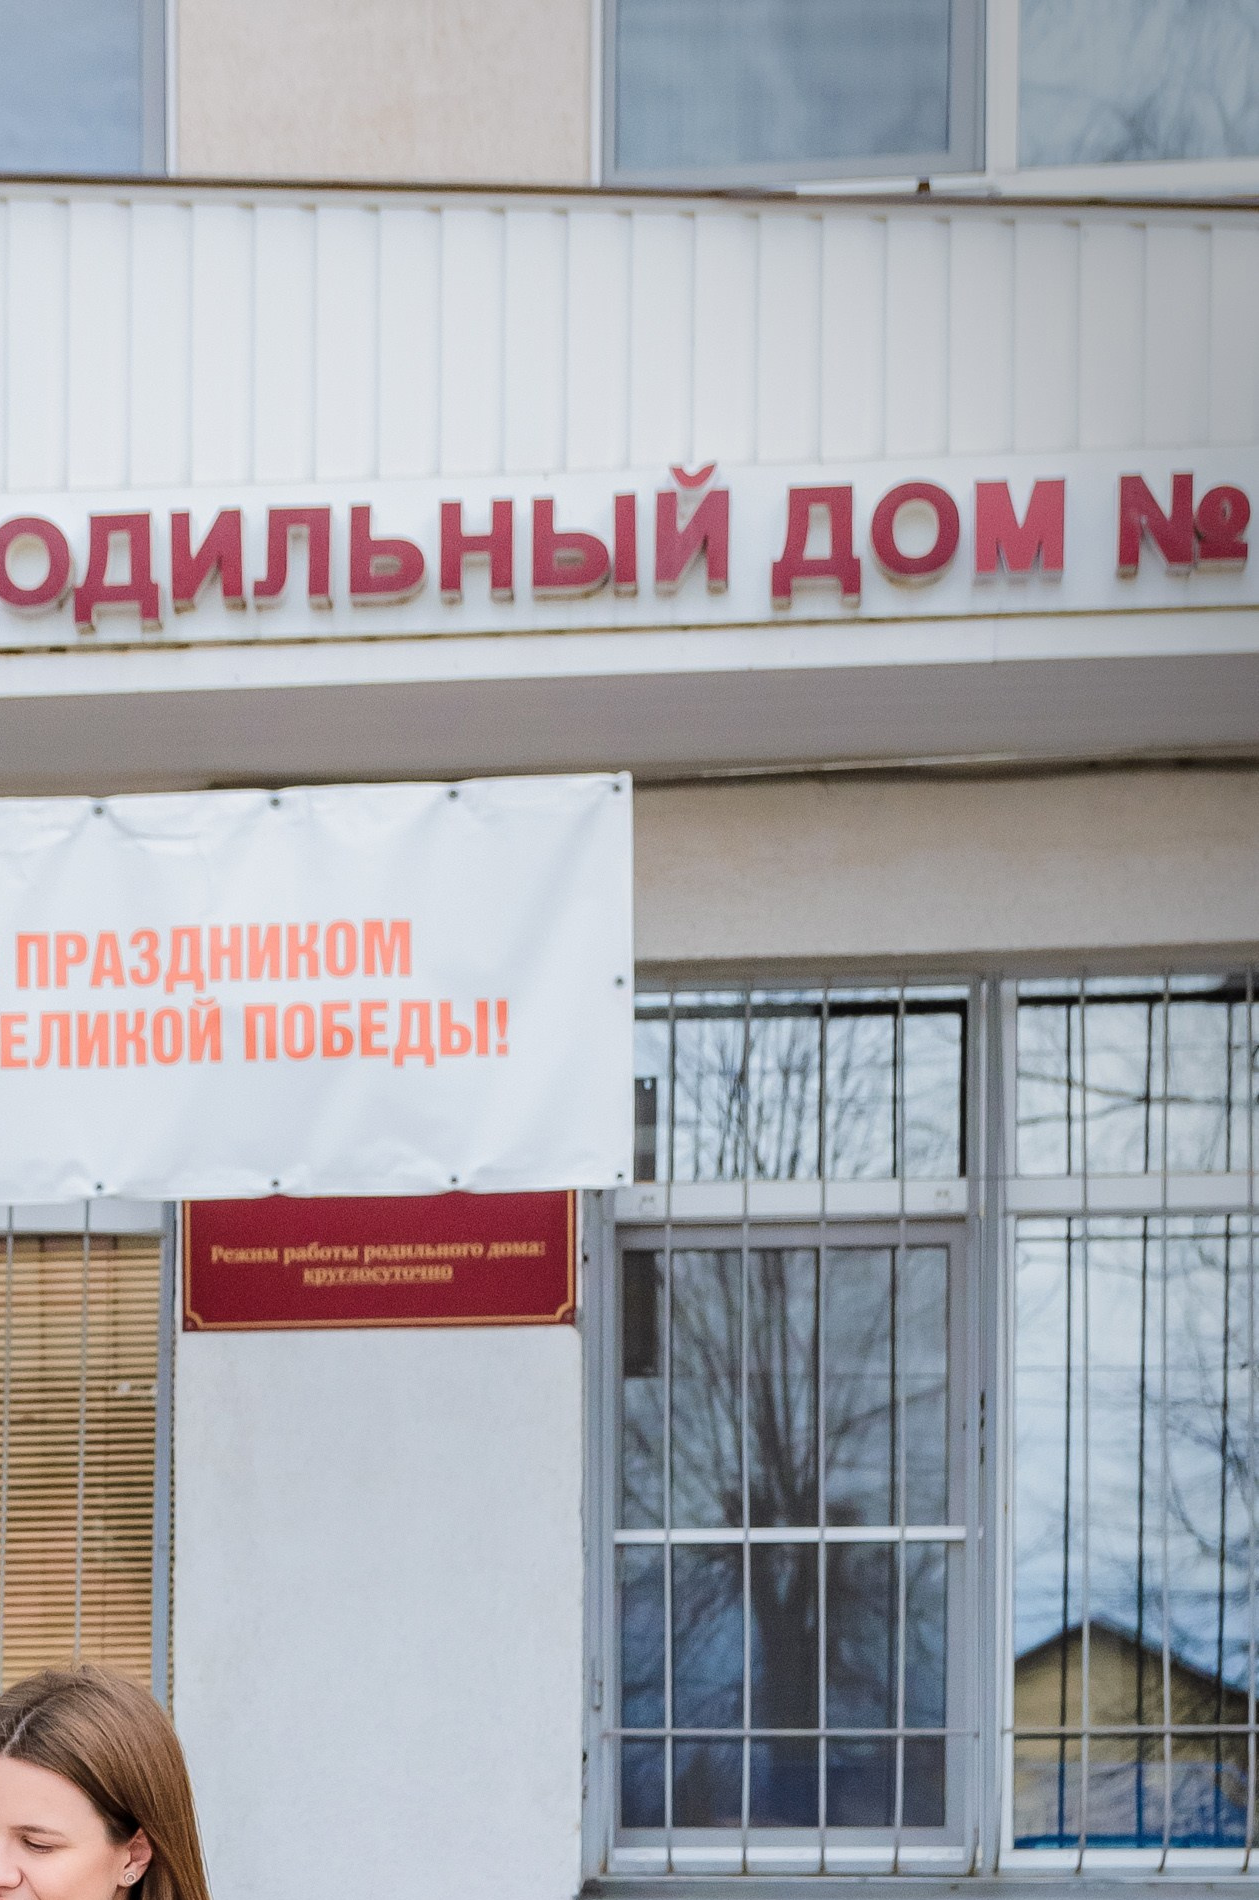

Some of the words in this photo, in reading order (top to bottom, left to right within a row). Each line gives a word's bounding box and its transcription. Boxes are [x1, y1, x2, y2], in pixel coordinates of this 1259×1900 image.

[770, 480, 1066, 598] ДОМ
[1118, 473, 1251, 575] №
[15, 919, 412, 994] ПРАЗДНИКОМ
[243, 998, 509, 1068] ПОБЕДЫ!
[210, 1244, 279, 1263] Режим
[283, 1241, 359, 1266] работы
[363, 1241, 484, 1265] родильного
[302, 1264, 454, 1288] круглосуточно
